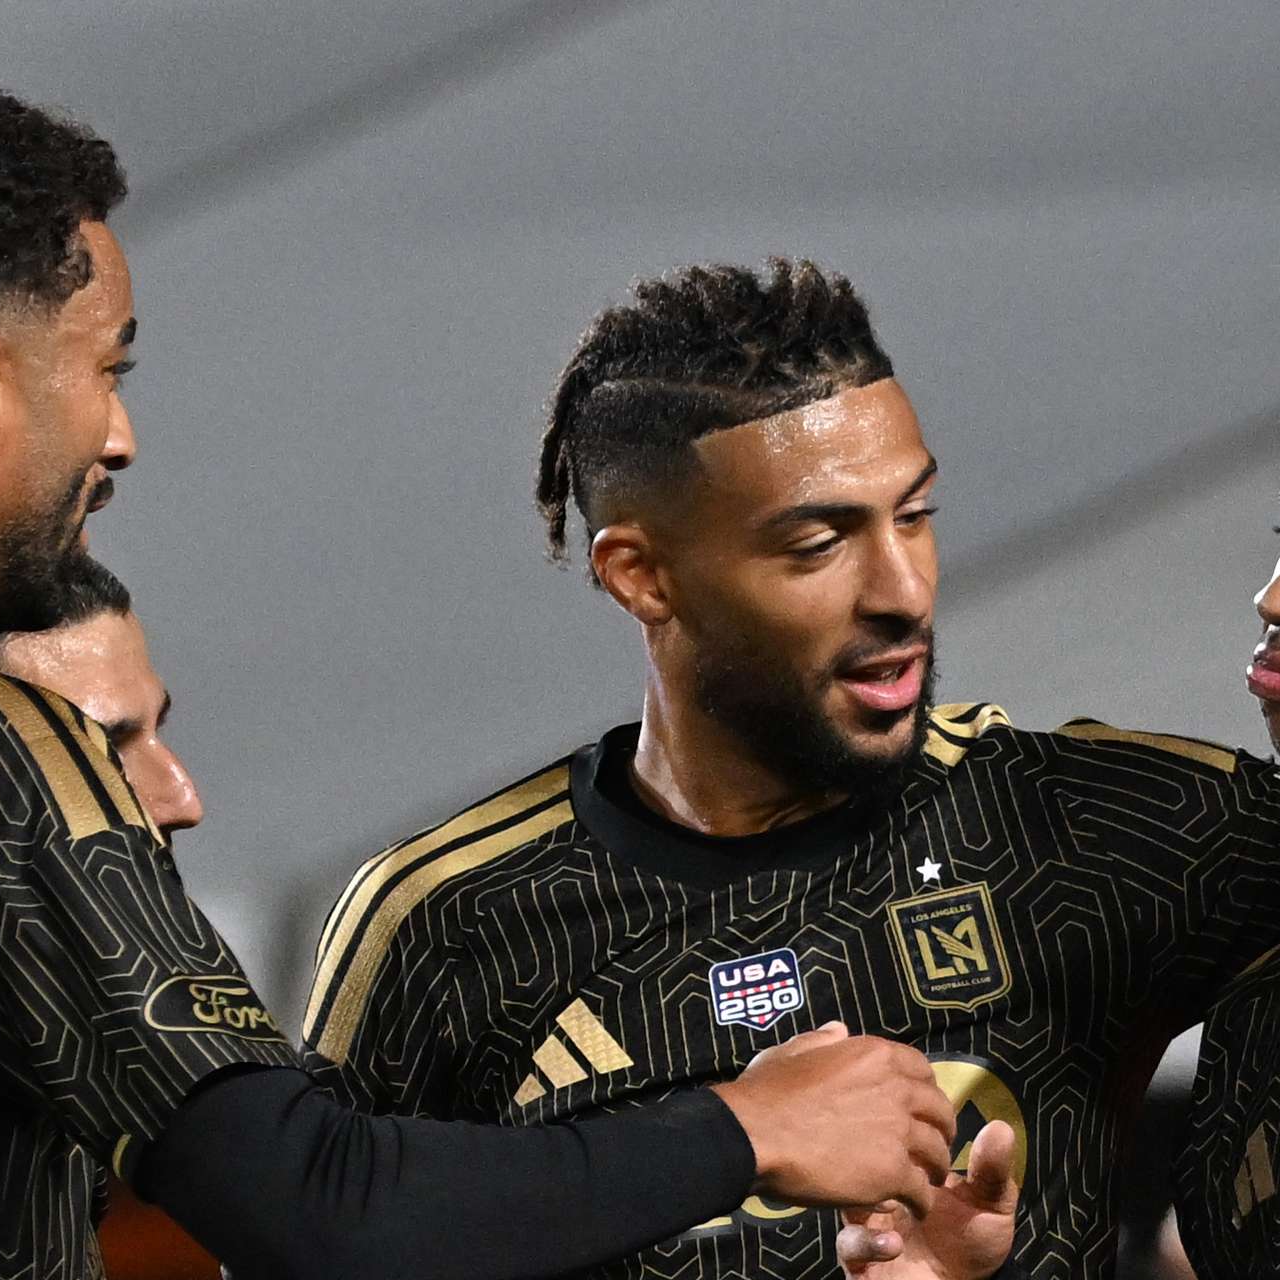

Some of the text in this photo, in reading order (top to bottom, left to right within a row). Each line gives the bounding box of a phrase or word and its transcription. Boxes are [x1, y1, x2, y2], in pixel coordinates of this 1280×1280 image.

[910, 903, 973, 923] LOS ANGELES
[718, 958, 792, 987] USA
[719, 986, 800, 1021] 250
